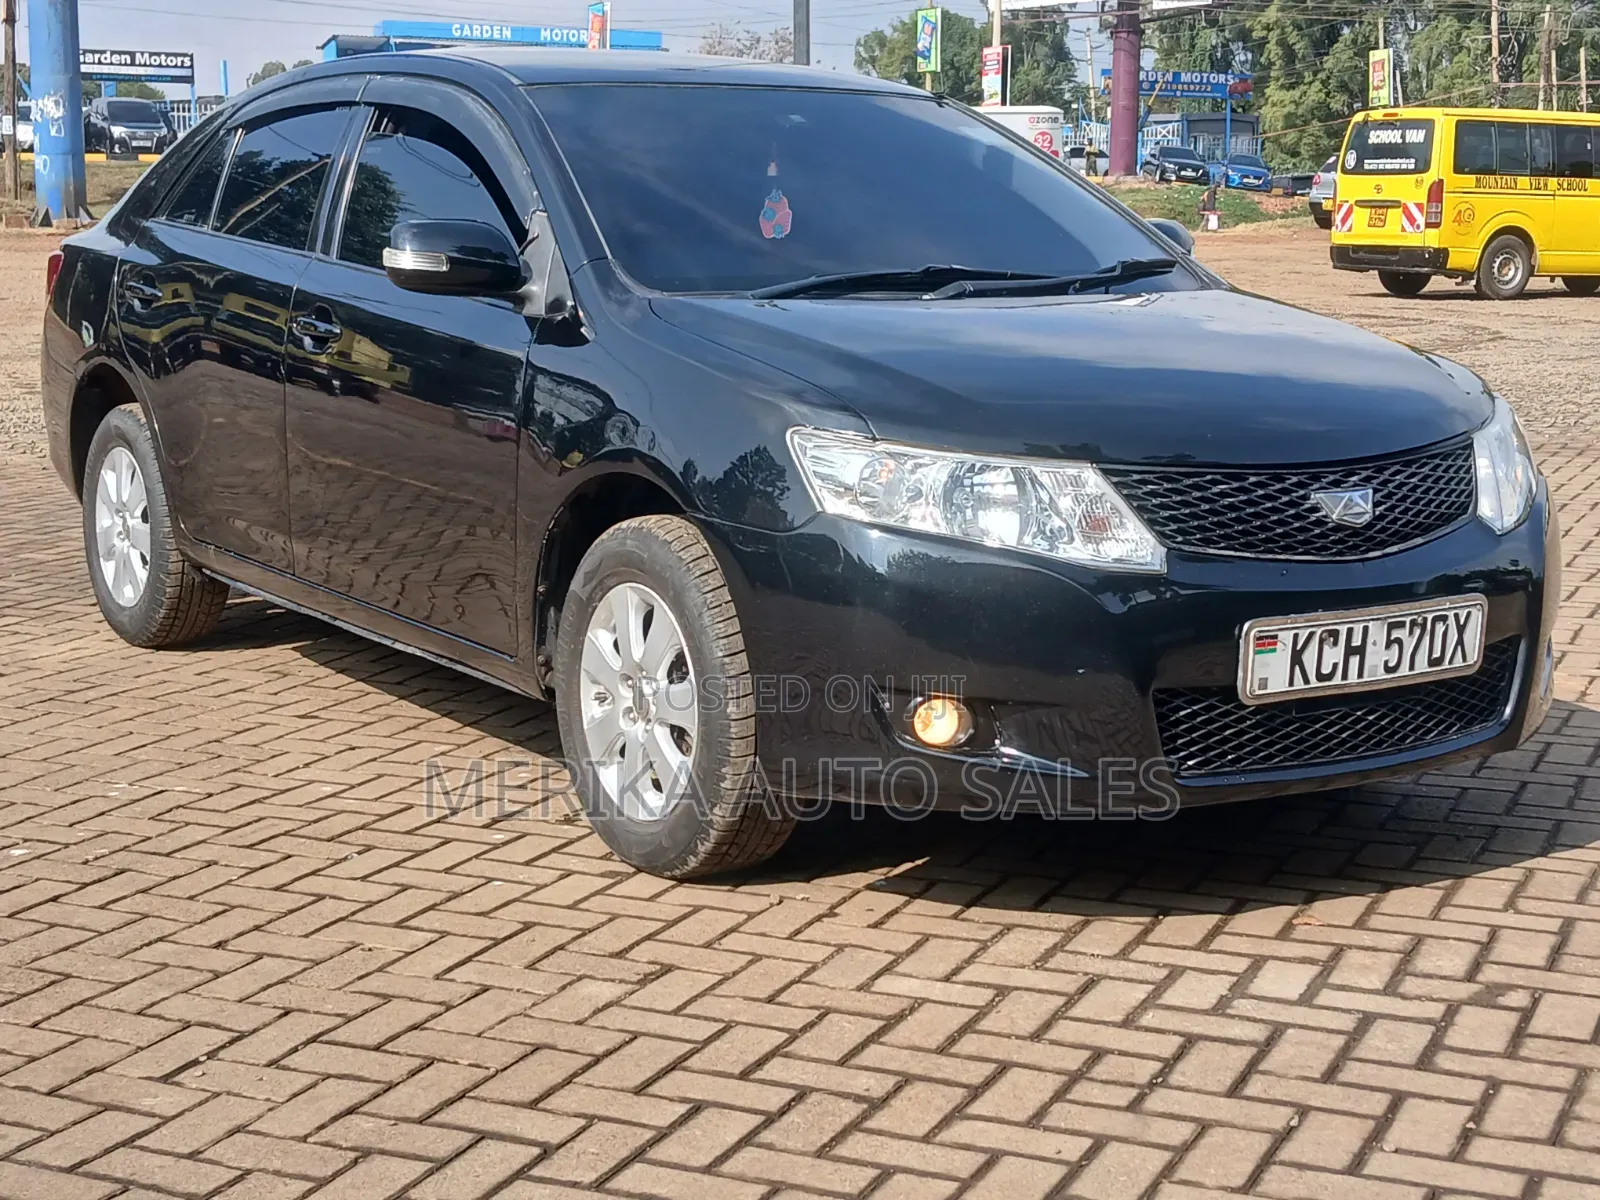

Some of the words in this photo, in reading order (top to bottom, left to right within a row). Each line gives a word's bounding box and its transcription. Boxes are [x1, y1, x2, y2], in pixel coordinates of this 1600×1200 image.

[451, 23, 512, 39] GARDEN
[540, 27, 588, 42] MOTOR
[135, 52, 192, 67] Motors
[1139, 71, 1173, 82] RDEN
[1180, 72, 1235, 84] MOTORS
[1035, 134, 1051, 147] 32
[1367, 129, 1403, 144] SCHOOL
[1405, 129, 1426, 143] VAN
[1474, 176, 1518, 190] MOUNTAIN
[1529, 177, 1549, 191] VIEW
[1556, 178, 1589, 192] SCHOOL
[1287, 624, 1369, 688] KCH
[1382, 610, 1472, 675] 570X
